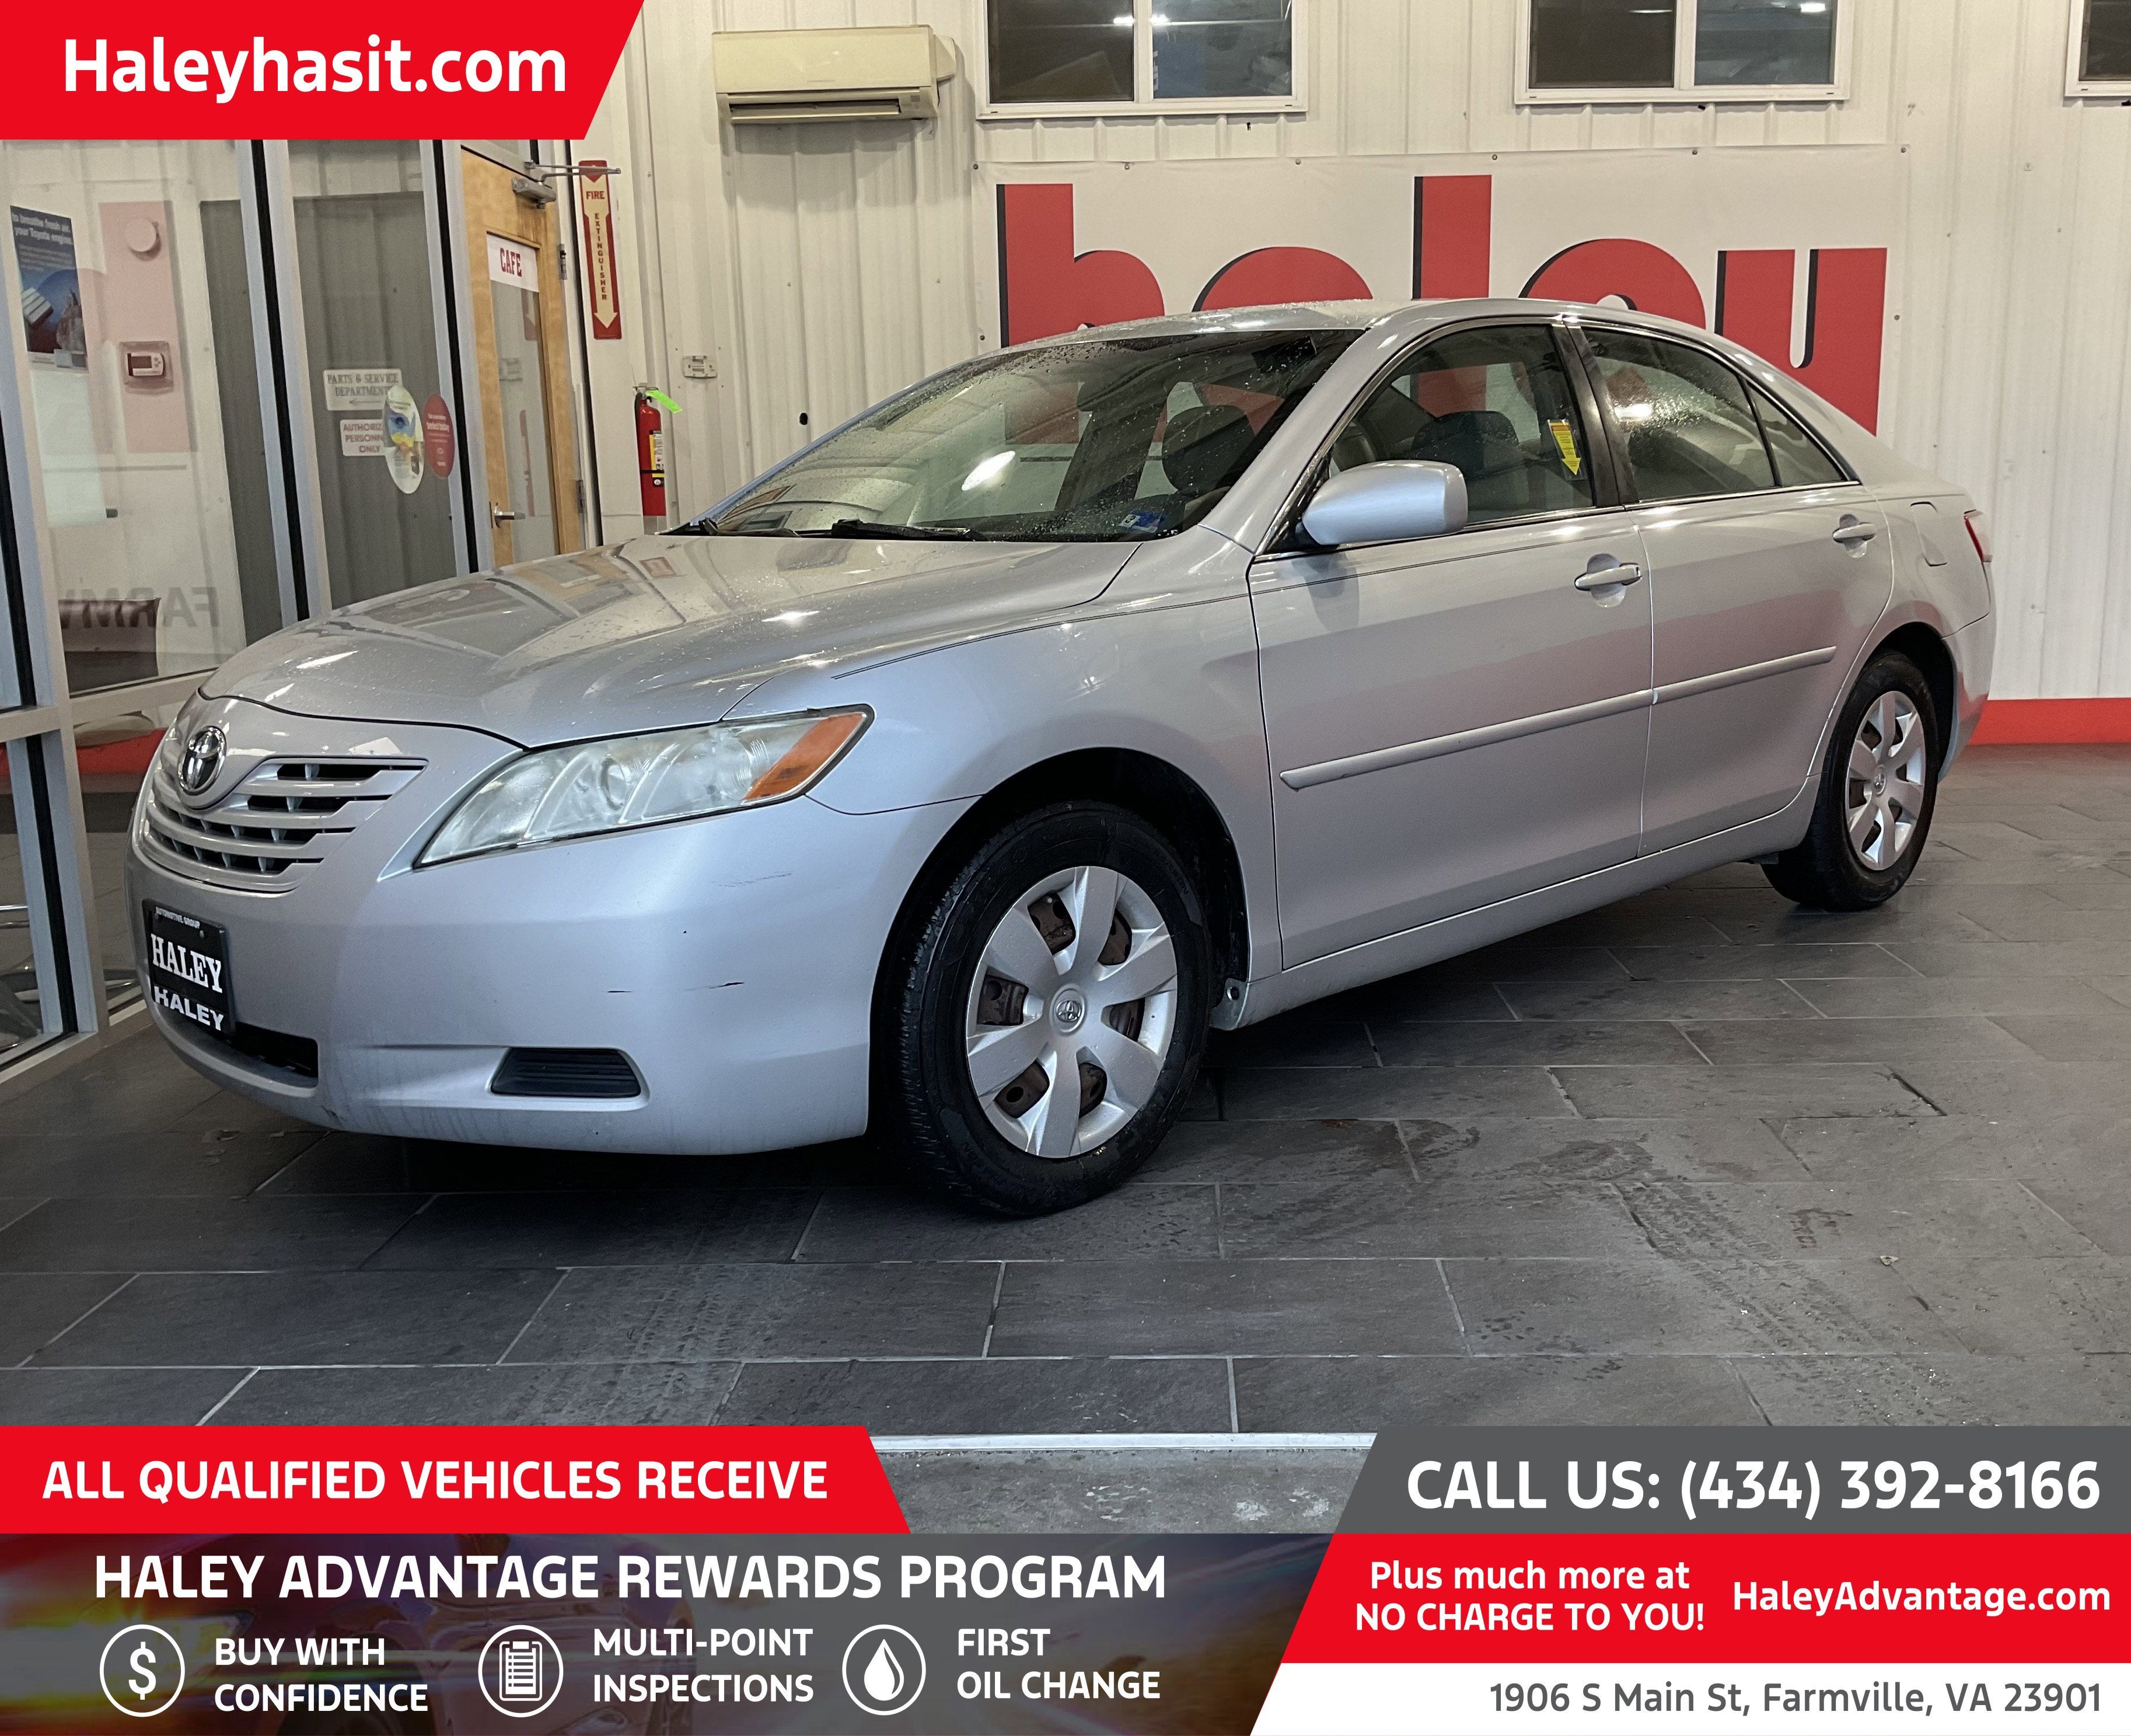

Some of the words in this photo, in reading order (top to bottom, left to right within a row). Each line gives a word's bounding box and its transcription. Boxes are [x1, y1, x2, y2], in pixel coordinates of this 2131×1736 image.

[586, 191, 605, 200] FIRE
[500, 247, 522, 277] CAFE
[595, 213, 607, 300] EXTINGUISHER
[327, 374, 352, 384] PARTS
[355, 374, 362, 383] &
[364, 373, 399, 383] SERVICE
[343, 423, 383, 431] AUTHORIZ
[151, 934, 222, 993] HALEY
[154, 986, 223, 1031] HALEY
